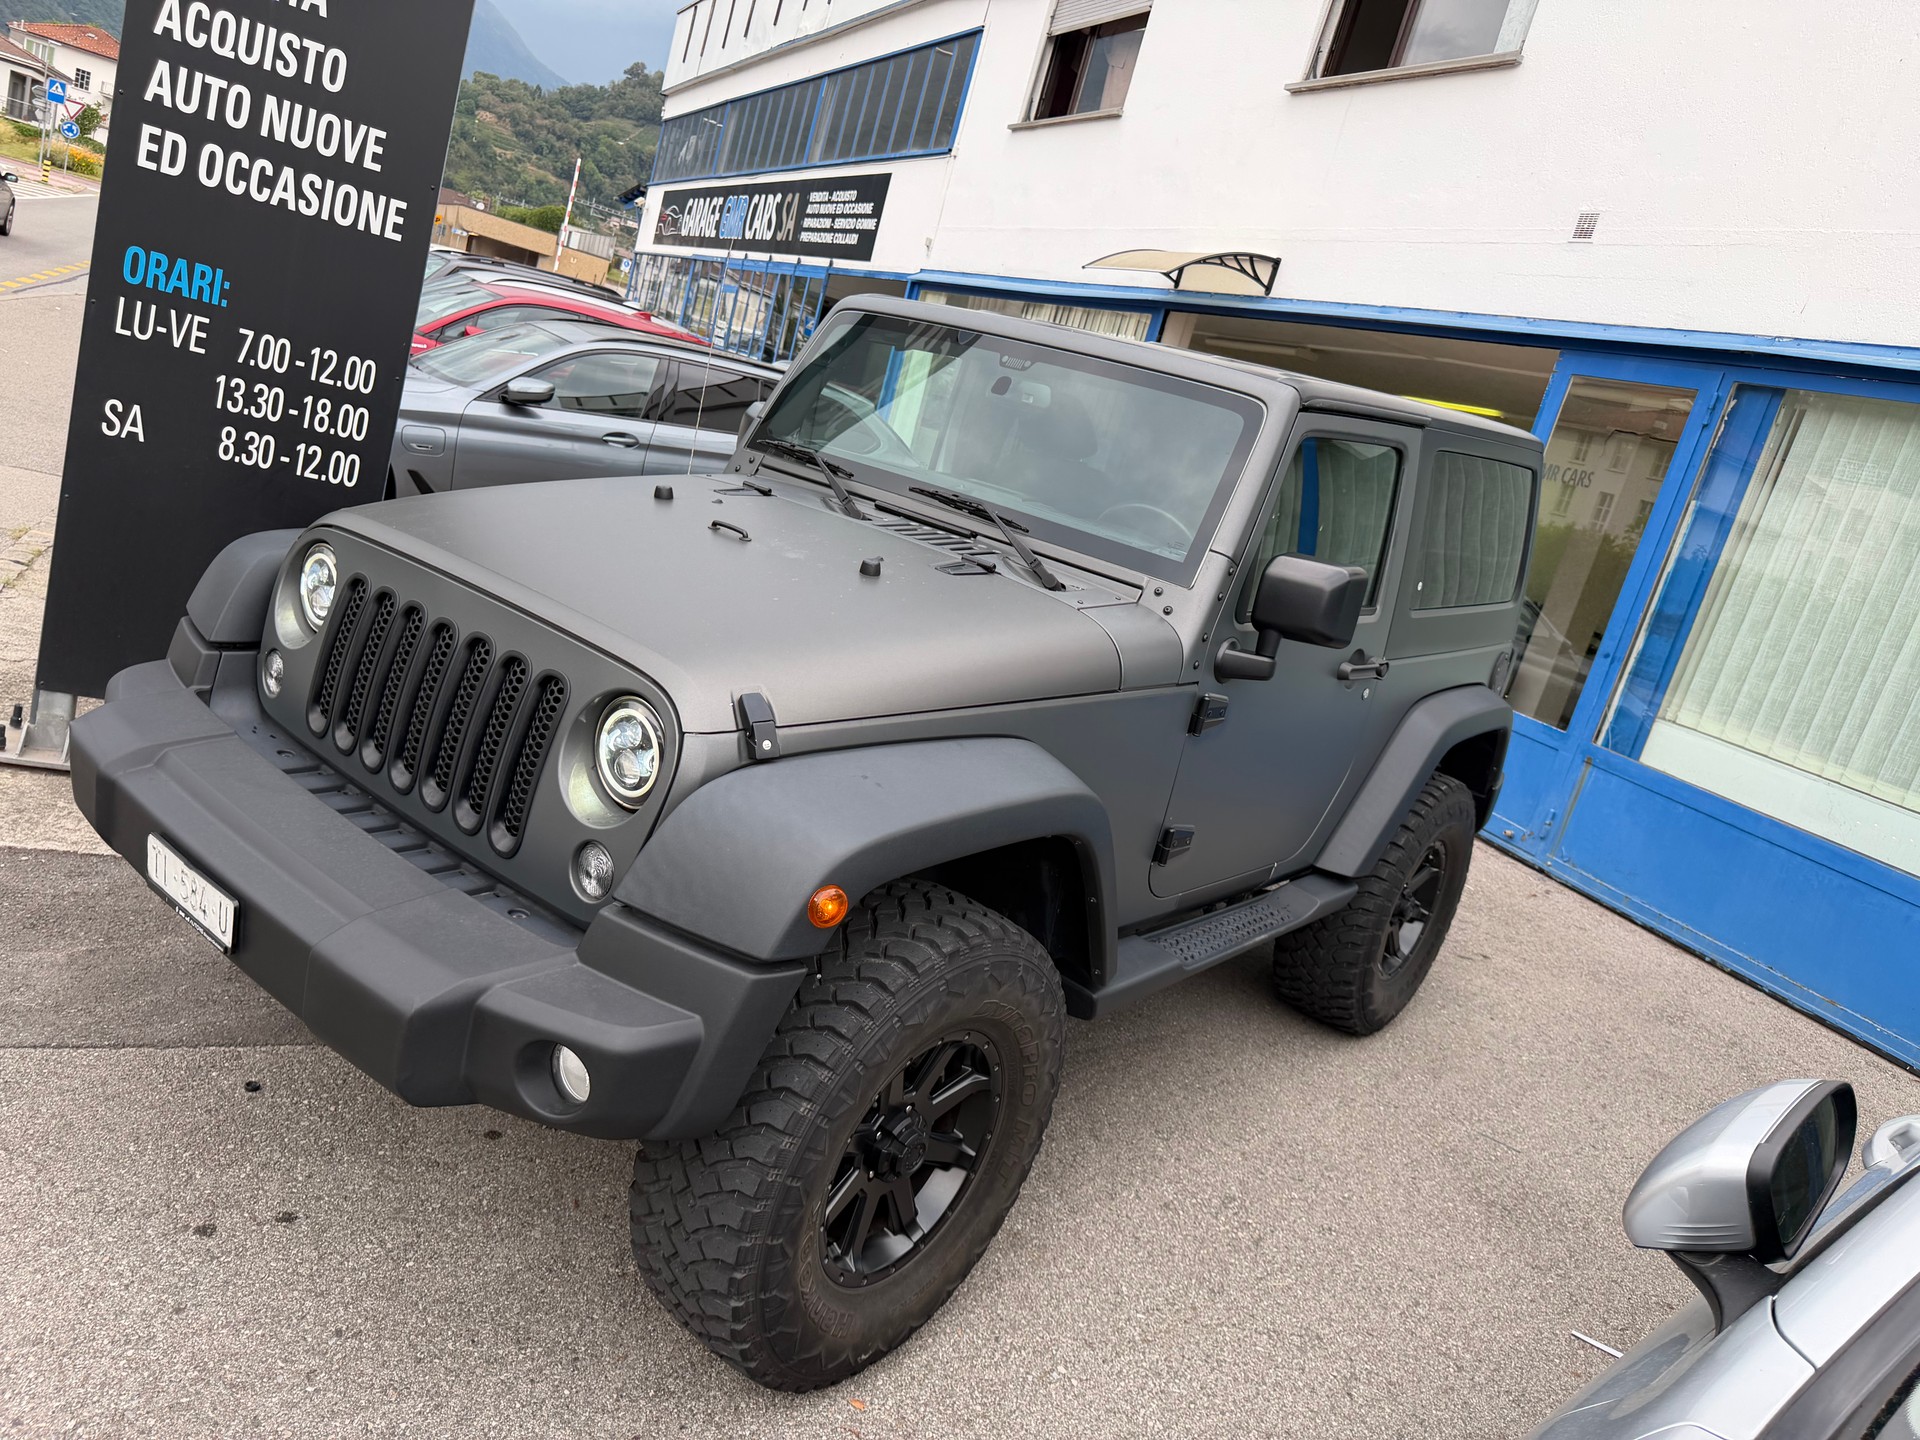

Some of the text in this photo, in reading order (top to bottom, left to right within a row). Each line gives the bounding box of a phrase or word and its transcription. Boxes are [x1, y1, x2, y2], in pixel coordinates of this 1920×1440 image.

[153, 0, 347, 93] ACQUISTO
[144, 60, 387, 172] AUTO NUOVE
[137, 123, 408, 242] ED OCCASIONE
[809, 191, 829, 202] VENDITA
[831, 190, 858, 202] ACQUISTO
[681, 197, 724, 238] GARAGE
[745, 192, 783, 240] CARS
[776, 192, 800, 241] SA
[802, 217, 832, 229] RIPARAZIONI
[834, 218, 856, 229] SERVIZIO
[856, 218, 878, 230] GOMME
[806, 202, 874, 215] AUTO NUOVE ED OCCASIONE
[799, 231, 859, 245] PREPARAZIONE COLLAUDI
[122, 245, 231, 307] ORARI:
[114, 297, 210, 355] LU-VE
[101, 399, 145, 443] SA
[1543, 463, 1595, 489] MR CARS
